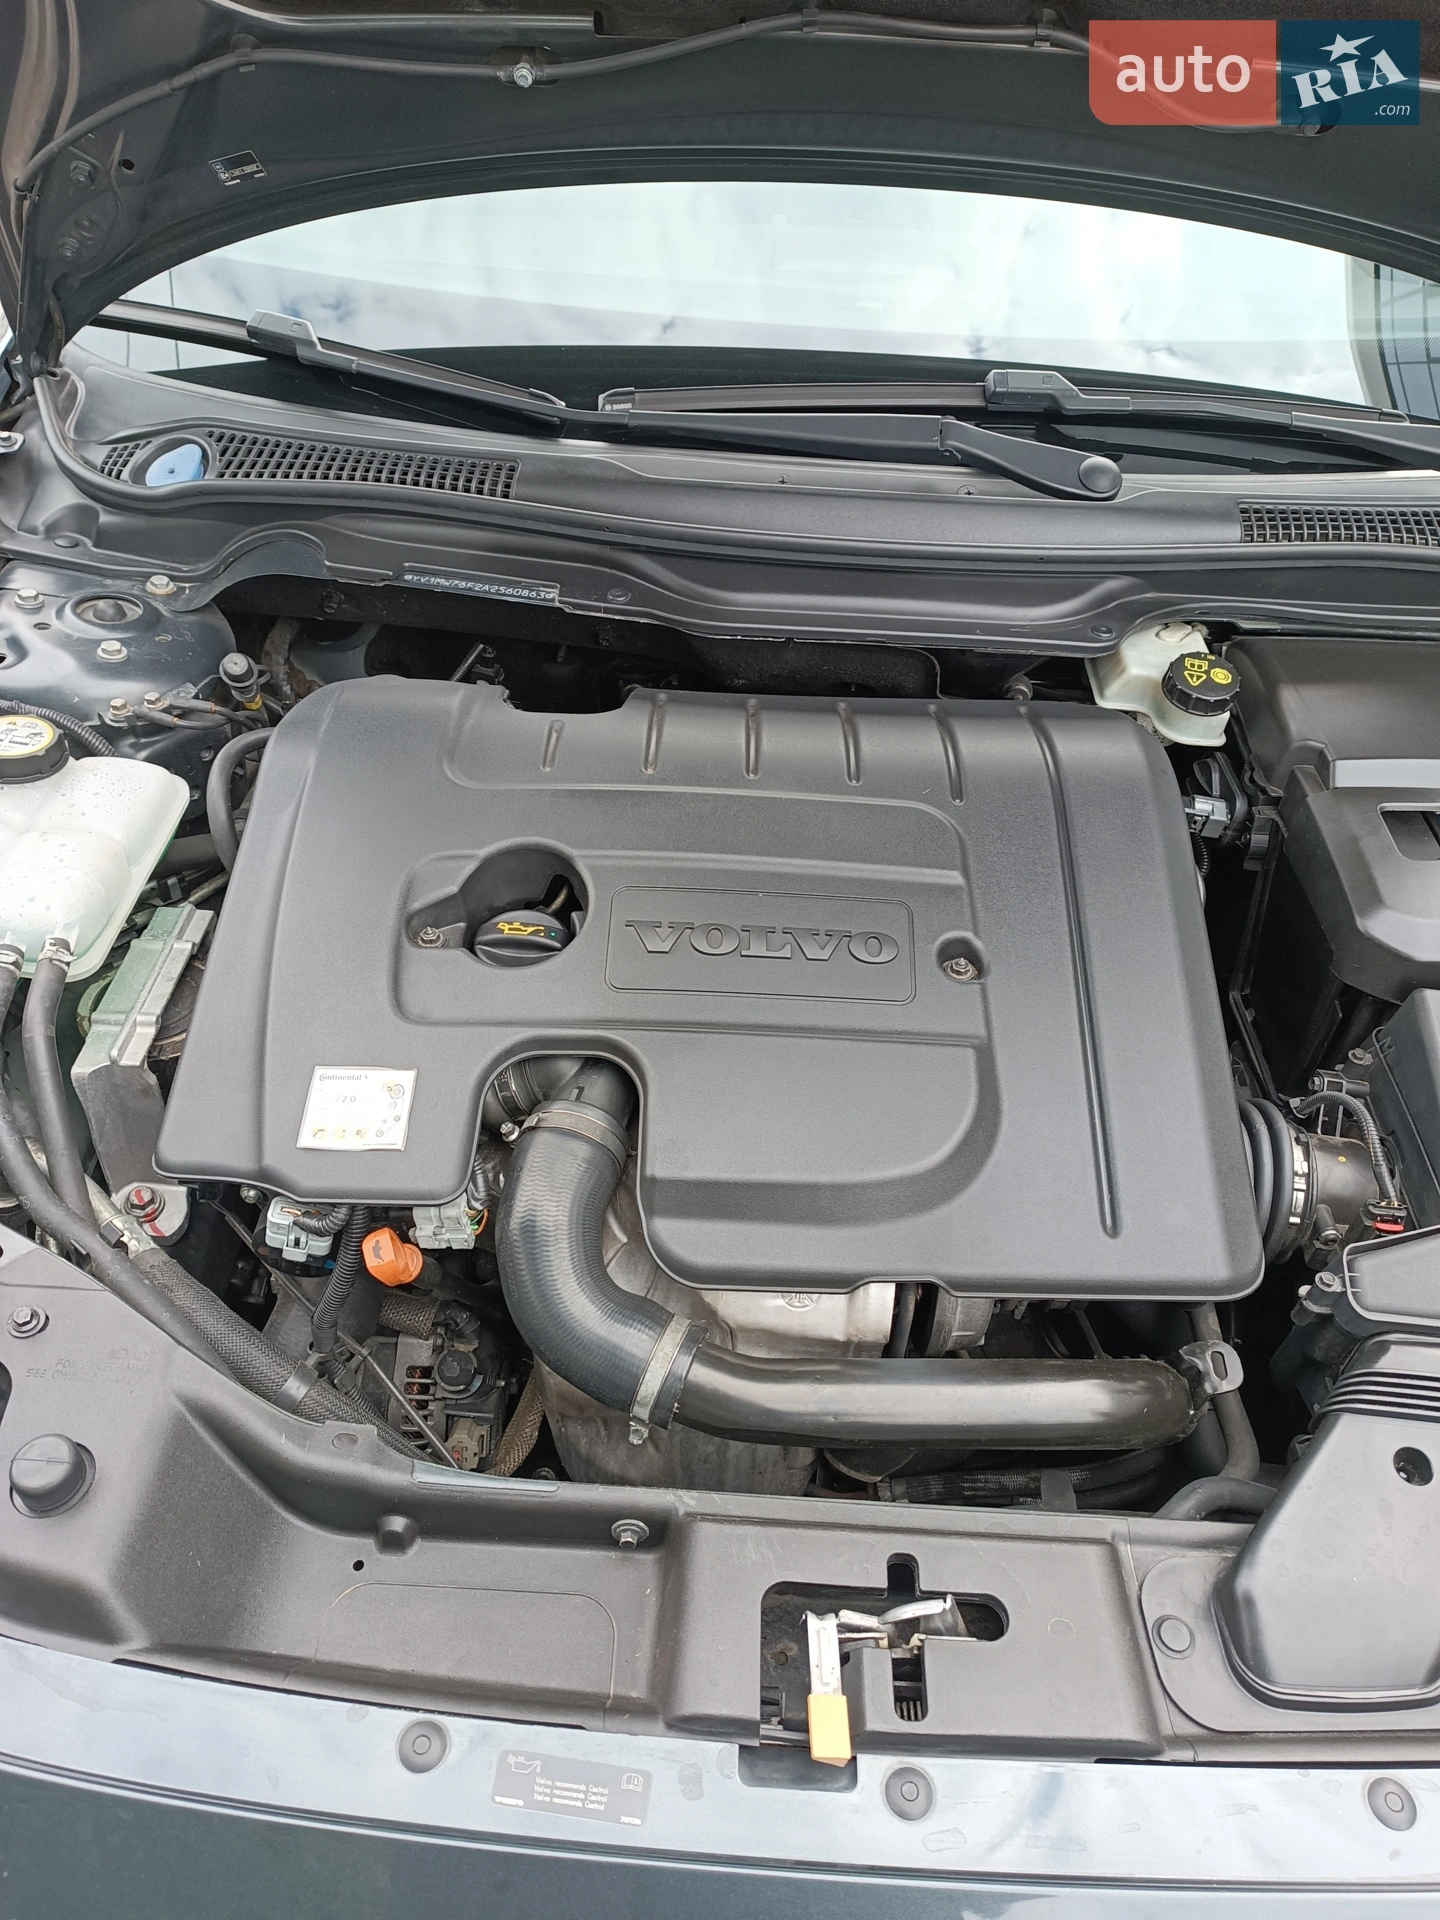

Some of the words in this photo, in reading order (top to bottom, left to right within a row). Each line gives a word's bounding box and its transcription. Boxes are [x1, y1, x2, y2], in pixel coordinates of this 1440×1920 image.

[625, 919, 900, 965] VOLVO
[319, 1074, 362, 1082] Continental
[534, 1784, 551, 1795] Volvo
[587, 1792, 608, 1803] Castrol
[535, 1776, 553, 1786] Volvo
[588, 1784, 609, 1795] Castrol
[533, 1792, 551, 1803] Volvo
[584, 1801, 605, 1811] Castrol
